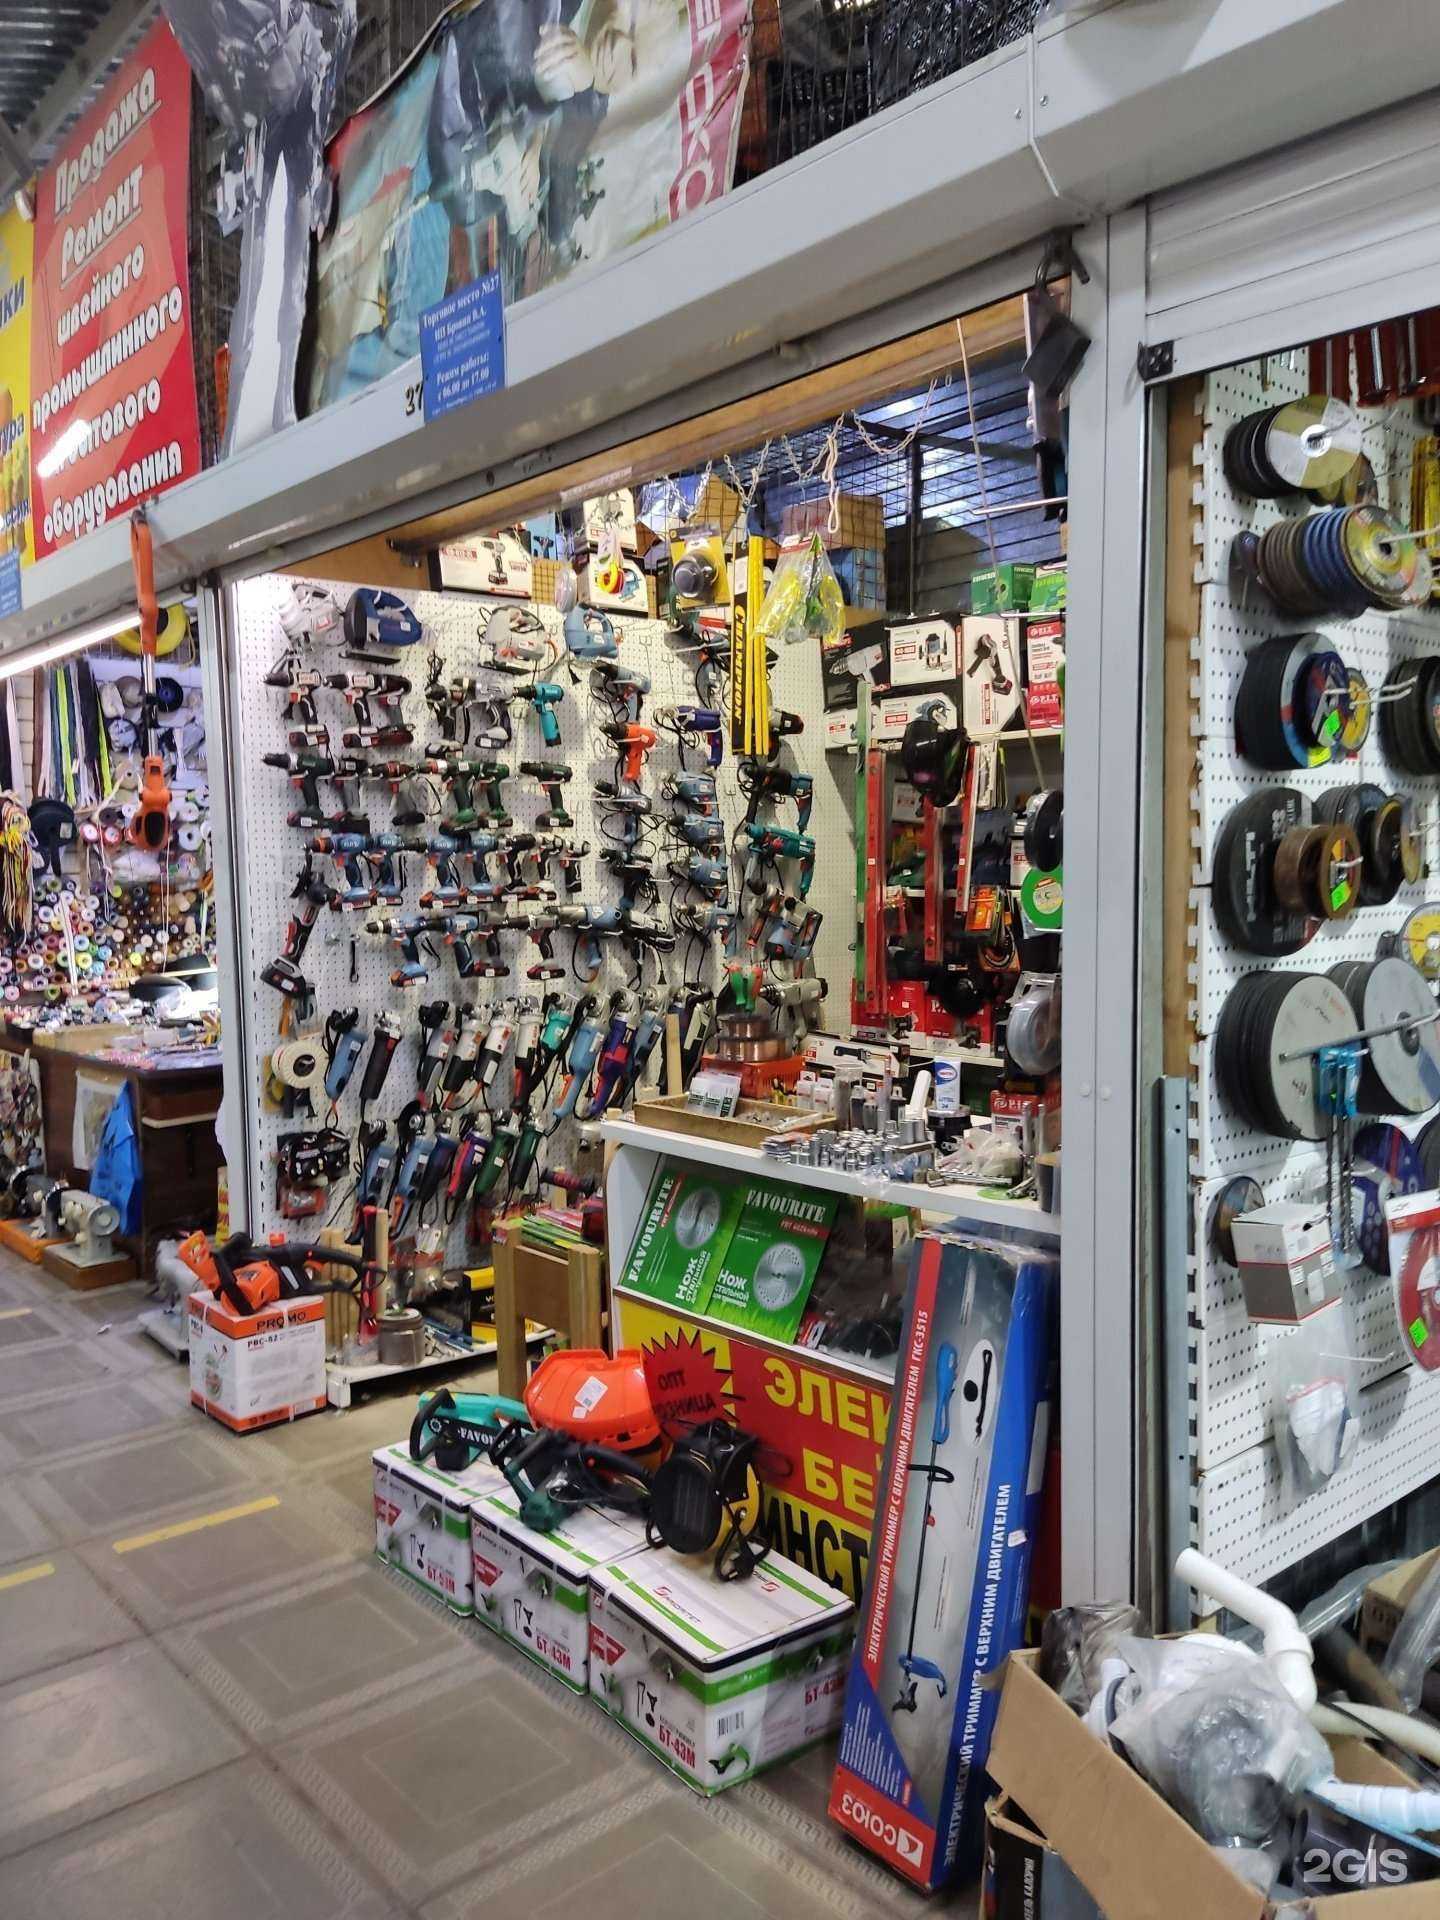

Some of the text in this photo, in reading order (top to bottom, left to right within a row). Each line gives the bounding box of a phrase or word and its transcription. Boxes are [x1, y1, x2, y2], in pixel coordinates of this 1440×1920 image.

[55, 67, 156, 217] Продажа
[61, 163, 143, 281] Ремонт
[57, 243, 144, 347] швейного
[423, 302, 456, 329] Торговое
[43, 440, 182, 544] оборудования
[628, 1176, 674, 1282] FAVOURITE
[746, 1189, 825, 1223] FAVOURITE
[717, 1268, 748, 1290] Нож
[900, 1365, 921, 1438] ДВИГАТЕЛЕМ
[893, 1440, 910, 1496] ВЕРХНИМ
[882, 1505, 900, 1563] ТРИММЕР
[986, 1484, 1011, 1581] ДВИГАТЕЛЕМ
[868, 1563, 891, 1664] ЭЛЕКТРИЧЕСКИЙ
[976, 1583, 998, 1655] ВЕРХНИМ
[842, 1793, 897, 1846] СОЮЗ
